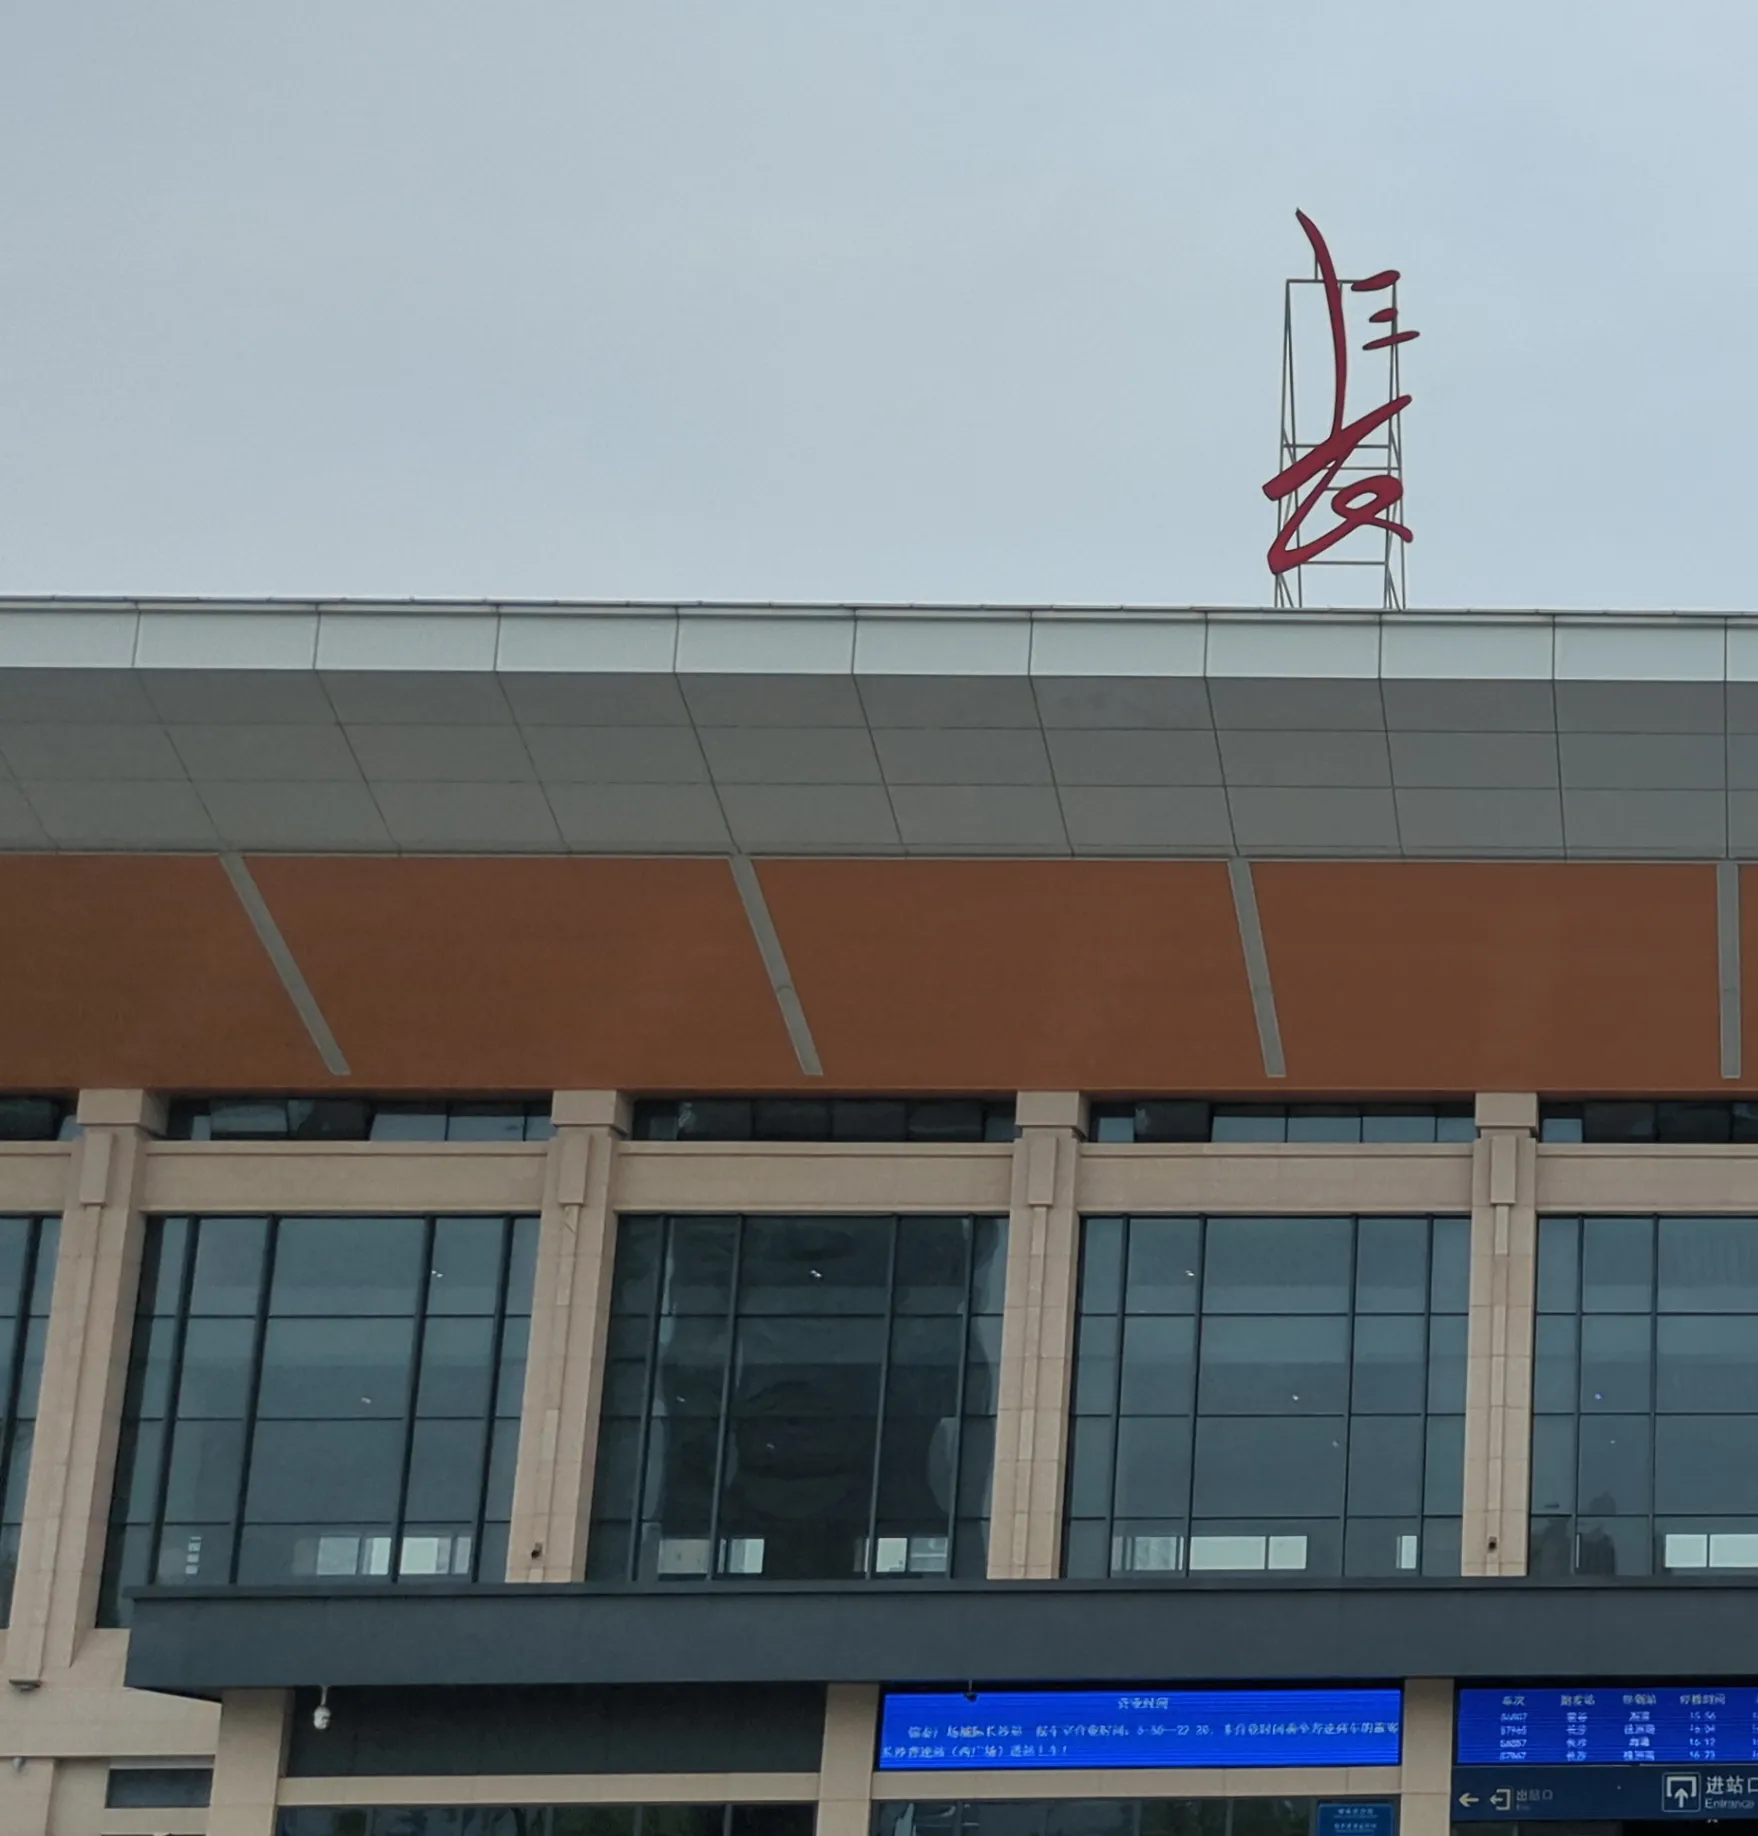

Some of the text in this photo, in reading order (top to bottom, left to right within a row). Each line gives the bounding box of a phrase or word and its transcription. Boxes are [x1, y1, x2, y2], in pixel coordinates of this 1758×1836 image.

[1516, 1788, 1554, 1801] 出站口
[1704, 1797, 1756, 1809] Entrance
